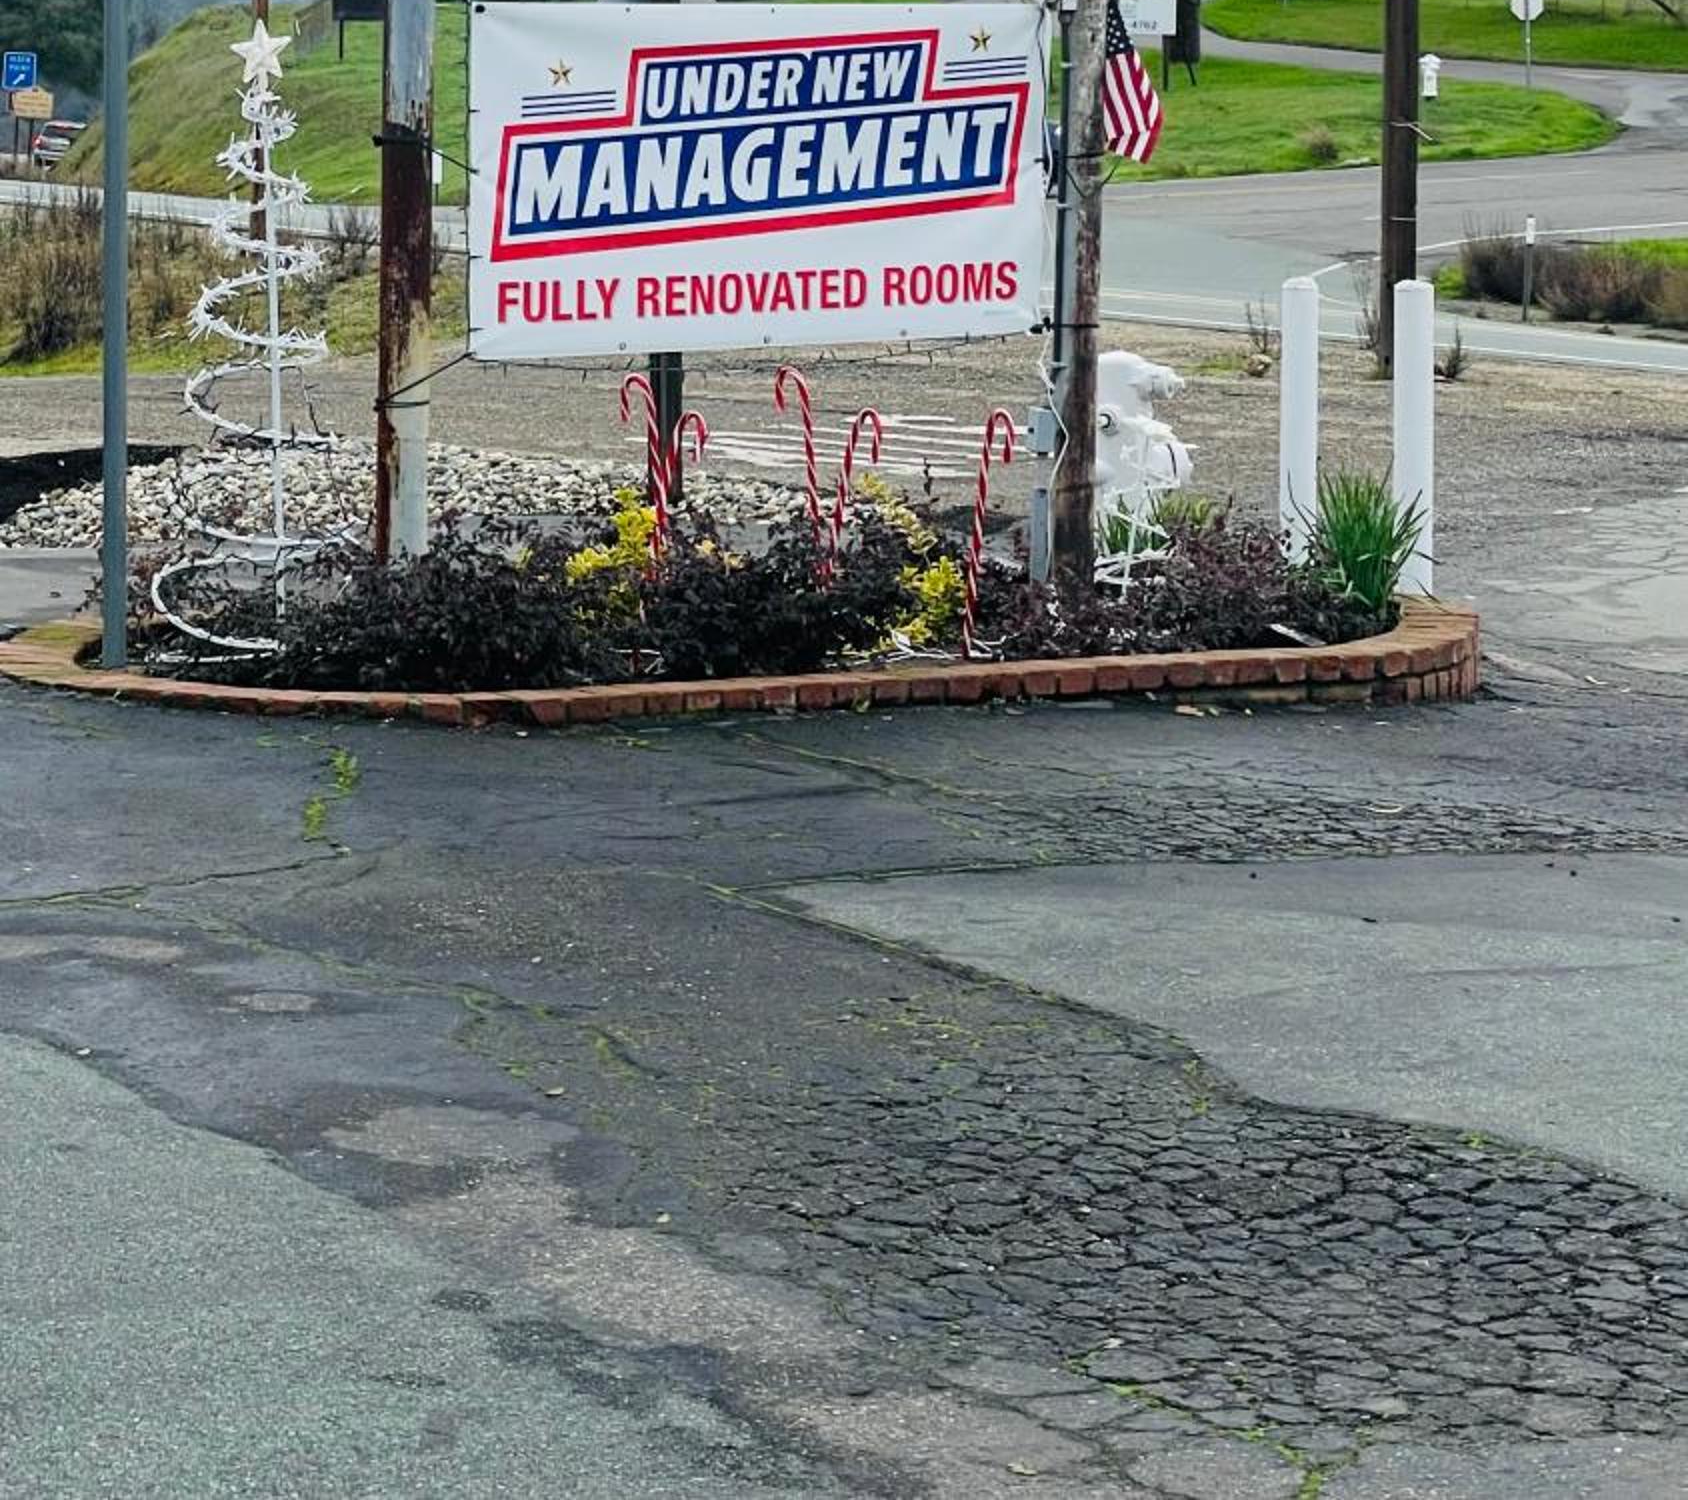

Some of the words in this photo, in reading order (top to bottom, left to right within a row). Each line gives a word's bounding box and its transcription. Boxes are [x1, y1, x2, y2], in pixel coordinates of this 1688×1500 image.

[645, 52, 807, 119] UNDER
[810, 49, 916, 102] NEW
[515, 106, 1009, 226] MANAGEMENT
[497, 277, 621, 324] FULLY
[636, 267, 867, 317] RENOVATED
[882, 260, 1019, 307] ROOMS
